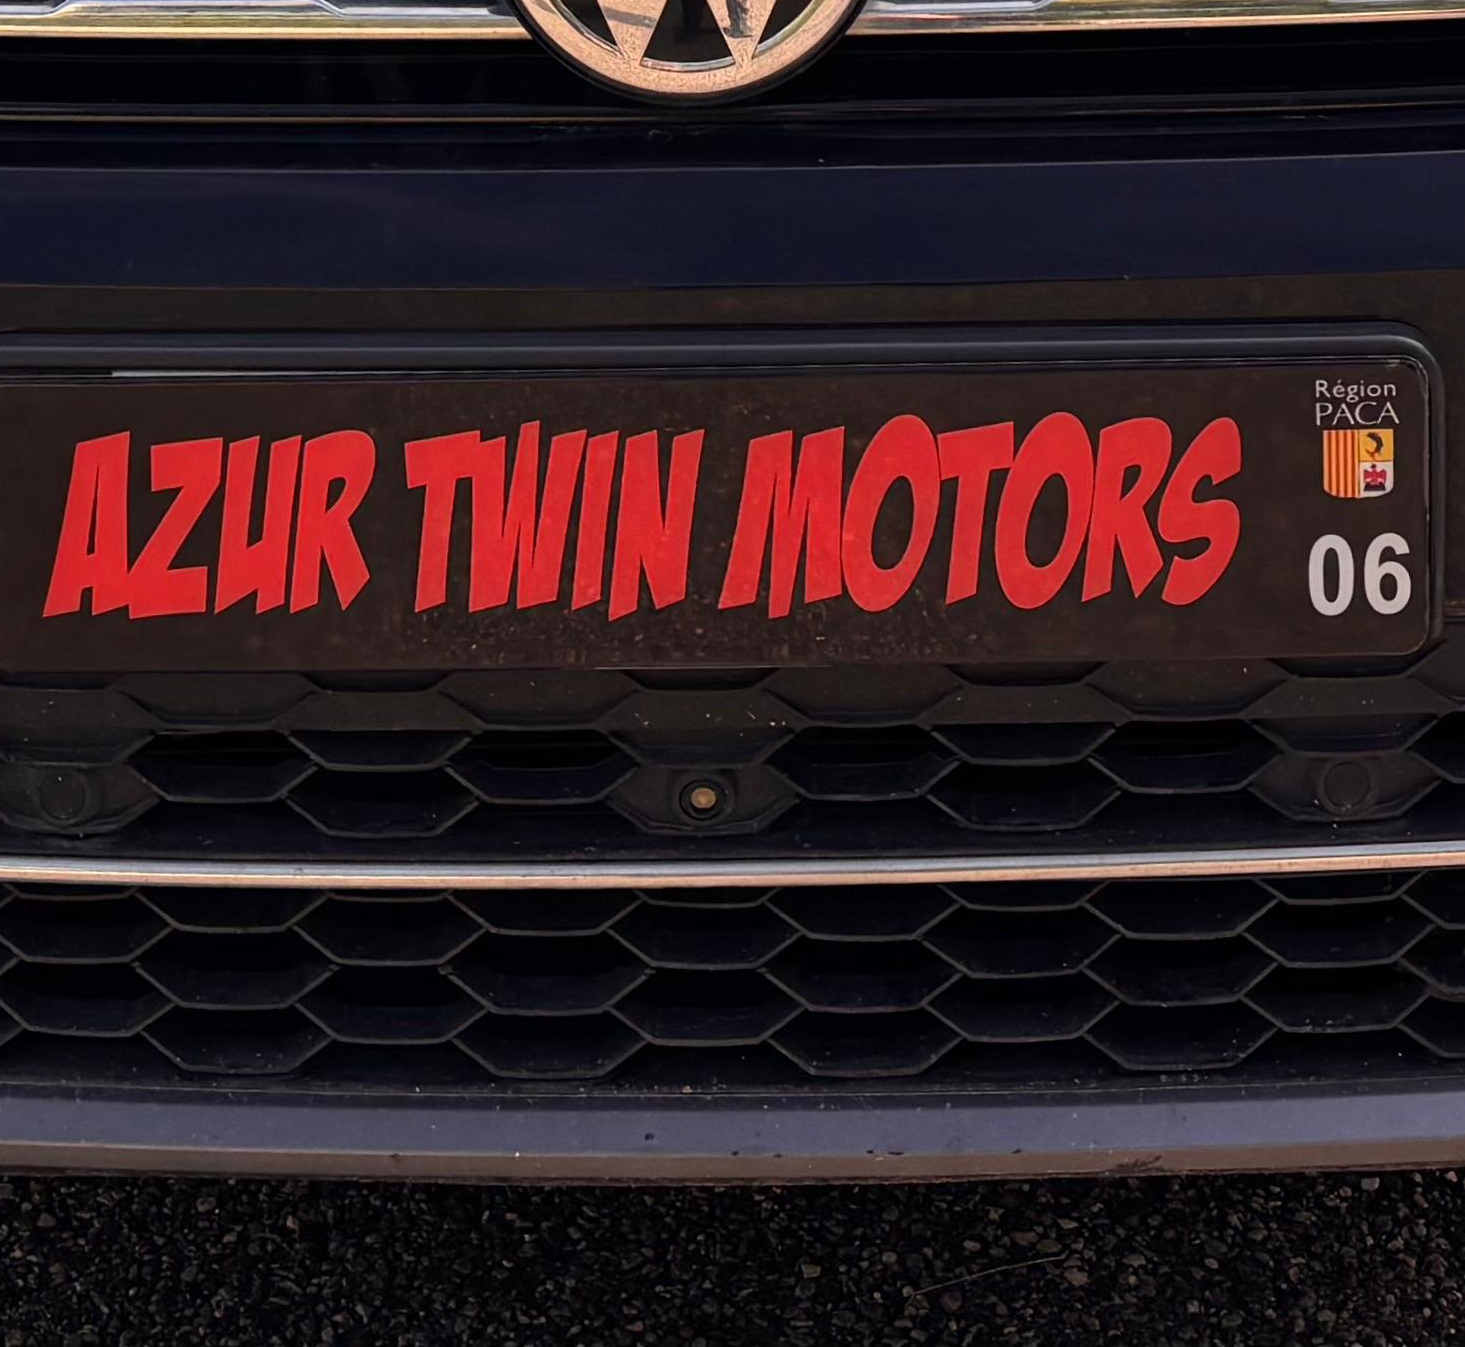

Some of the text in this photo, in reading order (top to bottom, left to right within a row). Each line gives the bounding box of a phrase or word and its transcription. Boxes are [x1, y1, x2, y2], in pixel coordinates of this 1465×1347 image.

[1315, 379, 1396, 403] Région
[1315, 401, 1400, 426] PACA
[43, 411, 1243, 622] AZUR TWIN MOTORS
[1308, 531, 1412, 617] 06
